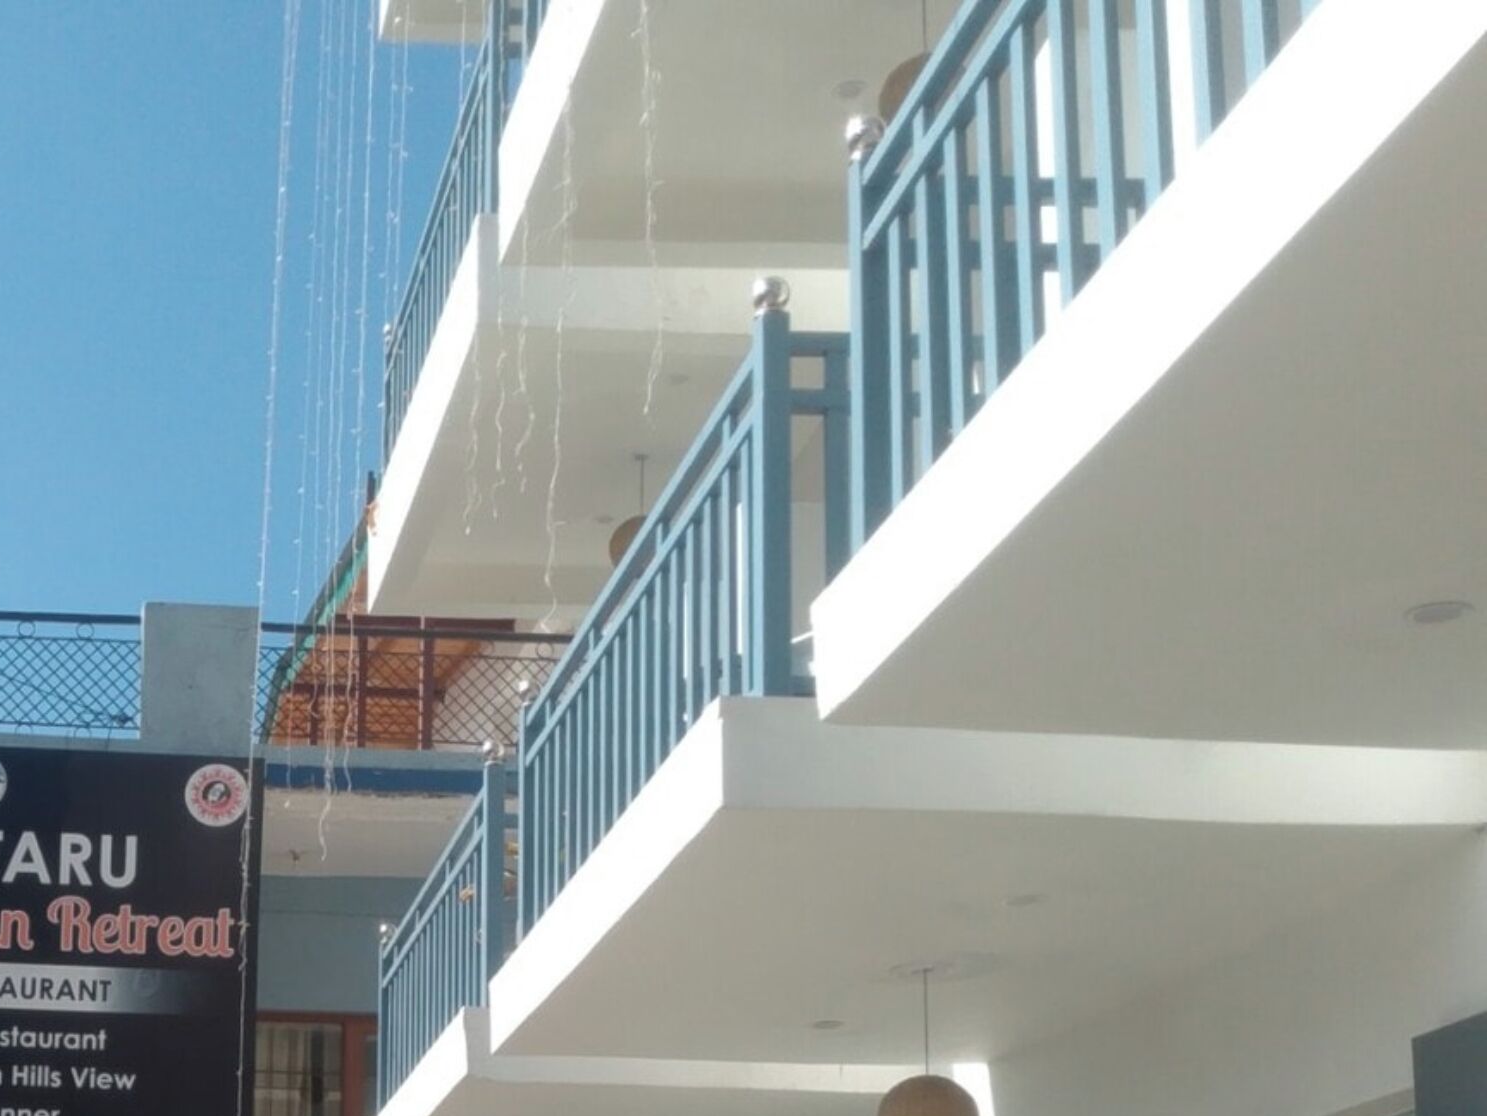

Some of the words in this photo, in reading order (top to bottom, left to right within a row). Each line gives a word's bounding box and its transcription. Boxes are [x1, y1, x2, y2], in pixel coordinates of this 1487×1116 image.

[46, 895, 236, 959] Retreat
[12, 1064, 62, 1090] Hills
[70, 1067, 136, 1092] View
